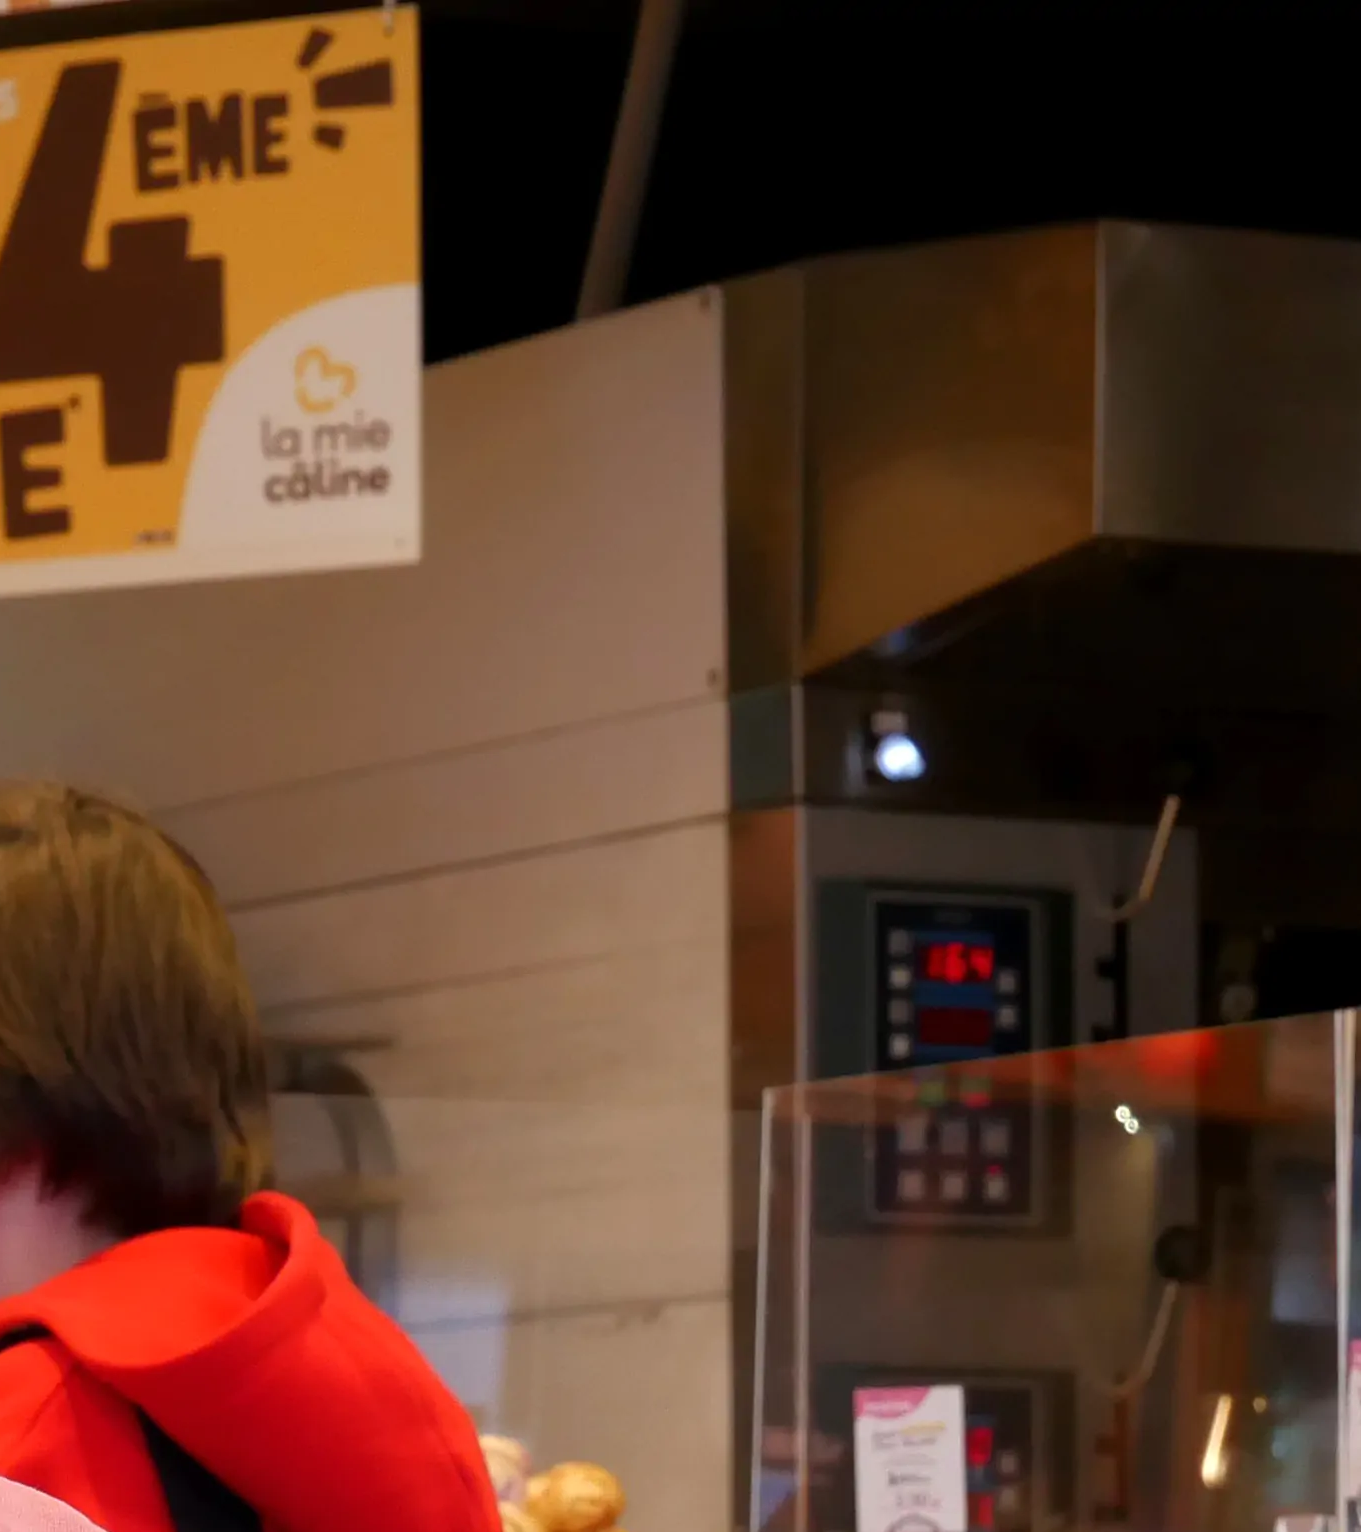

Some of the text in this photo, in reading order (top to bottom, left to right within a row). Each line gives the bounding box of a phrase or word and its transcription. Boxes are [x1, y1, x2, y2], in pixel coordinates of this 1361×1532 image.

[260, 409, 392, 460] la mie
[263, 458, 392, 504] câline
